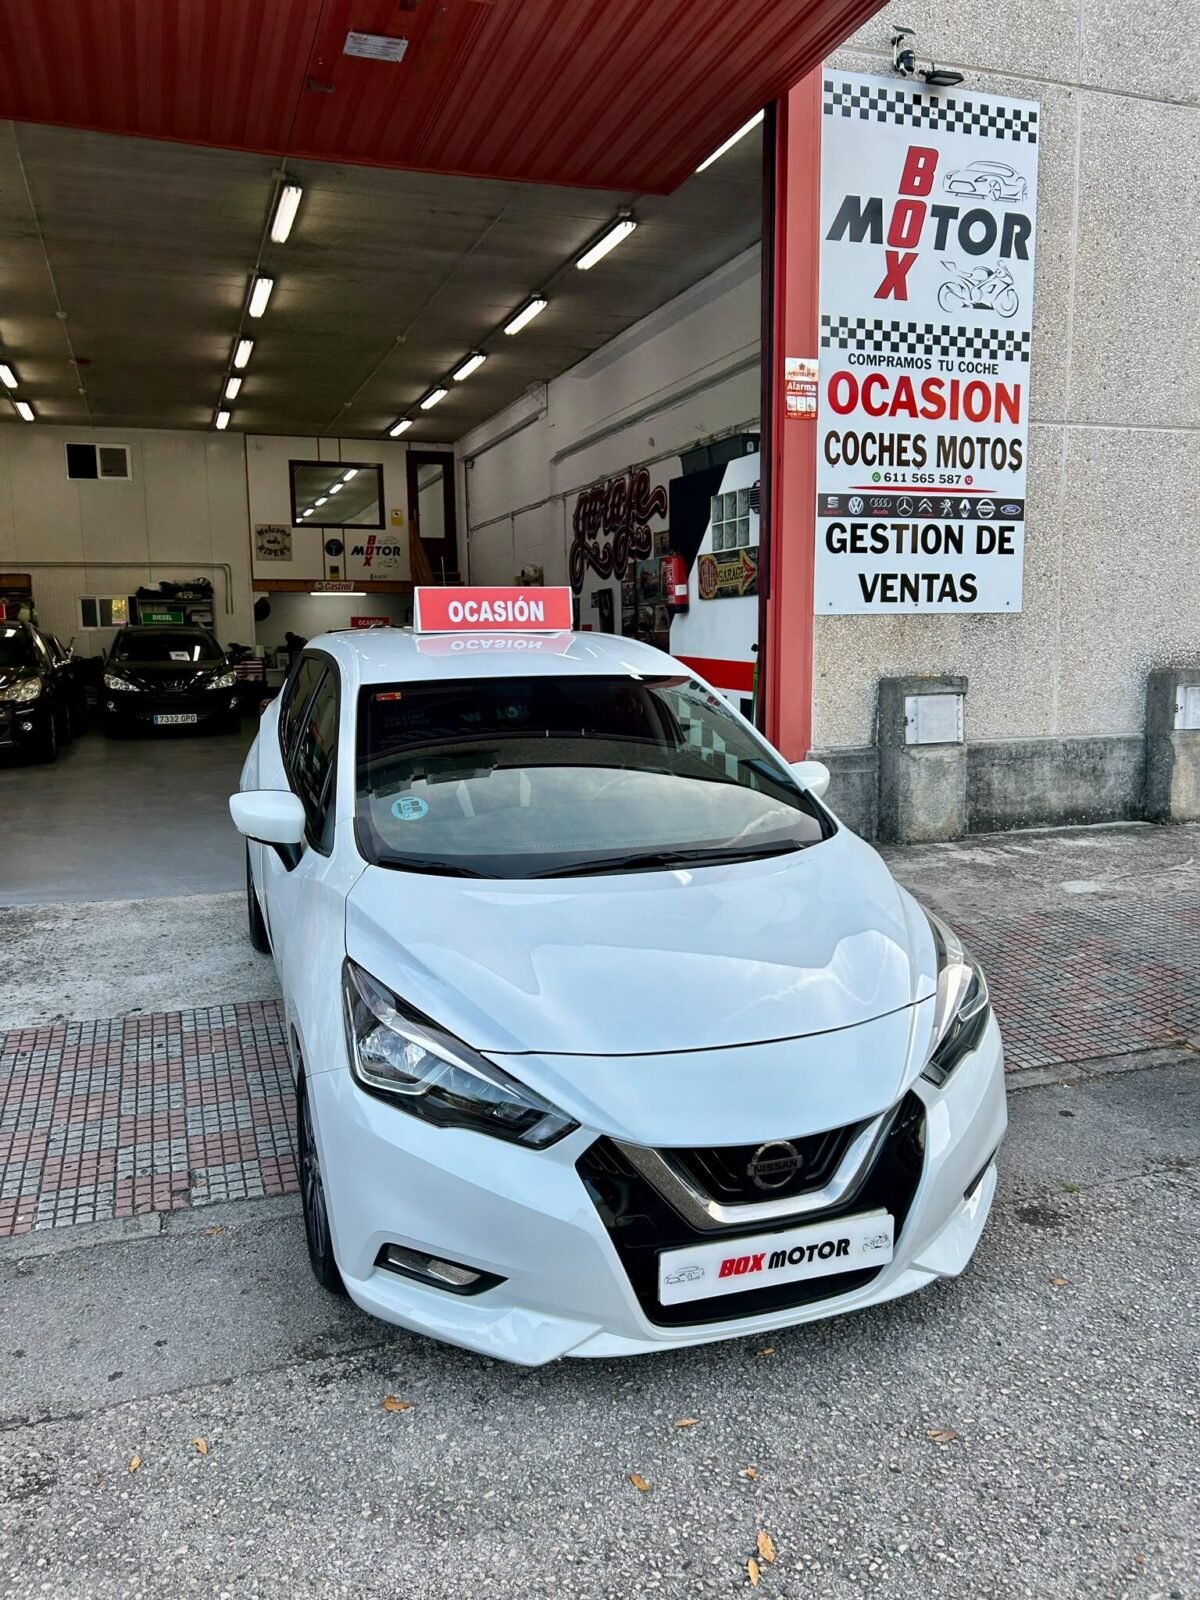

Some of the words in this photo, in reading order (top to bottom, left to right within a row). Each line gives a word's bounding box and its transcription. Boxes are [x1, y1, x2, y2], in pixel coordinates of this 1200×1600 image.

[825, 194, 1032, 261] MOTOR
[873, 145, 939, 301] BOX
[848, 353, 932, 370] COMPRAMOS
[938, 359, 954, 372] TU
[958, 361, 999, 375] COCHE
[787, 381, 816, 392] Alarma
[827, 370, 1021, 425] OCASION
[824, 430, 928, 467] COCHES
[936, 435, 1023, 472] MOTOS
[884, 472, 907, 483] 611
[911, 473, 935, 484] 565
[938, 474, 962, 485] 587
[257, 525, 291, 537] Welcome
[825, 522, 963, 554] GESTION
[976, 525, 1015, 555] DE
[257, 544, 291, 557] RIDERS
[350, 545, 400, 556] MOTOR
[718, 566, 744, 582] GARAGE
[324, 582, 352, 591] Castrol
[858, 573, 978, 603] VENTAS
[152, 614, 173, 622] DIESEL
[448, 595, 544, 622] OCASIÓN
[753, 1159, 798, 1176] NISSAN
[718, 1252, 767, 1279] BOX
[768, 1238, 850, 1269] MOTOR
